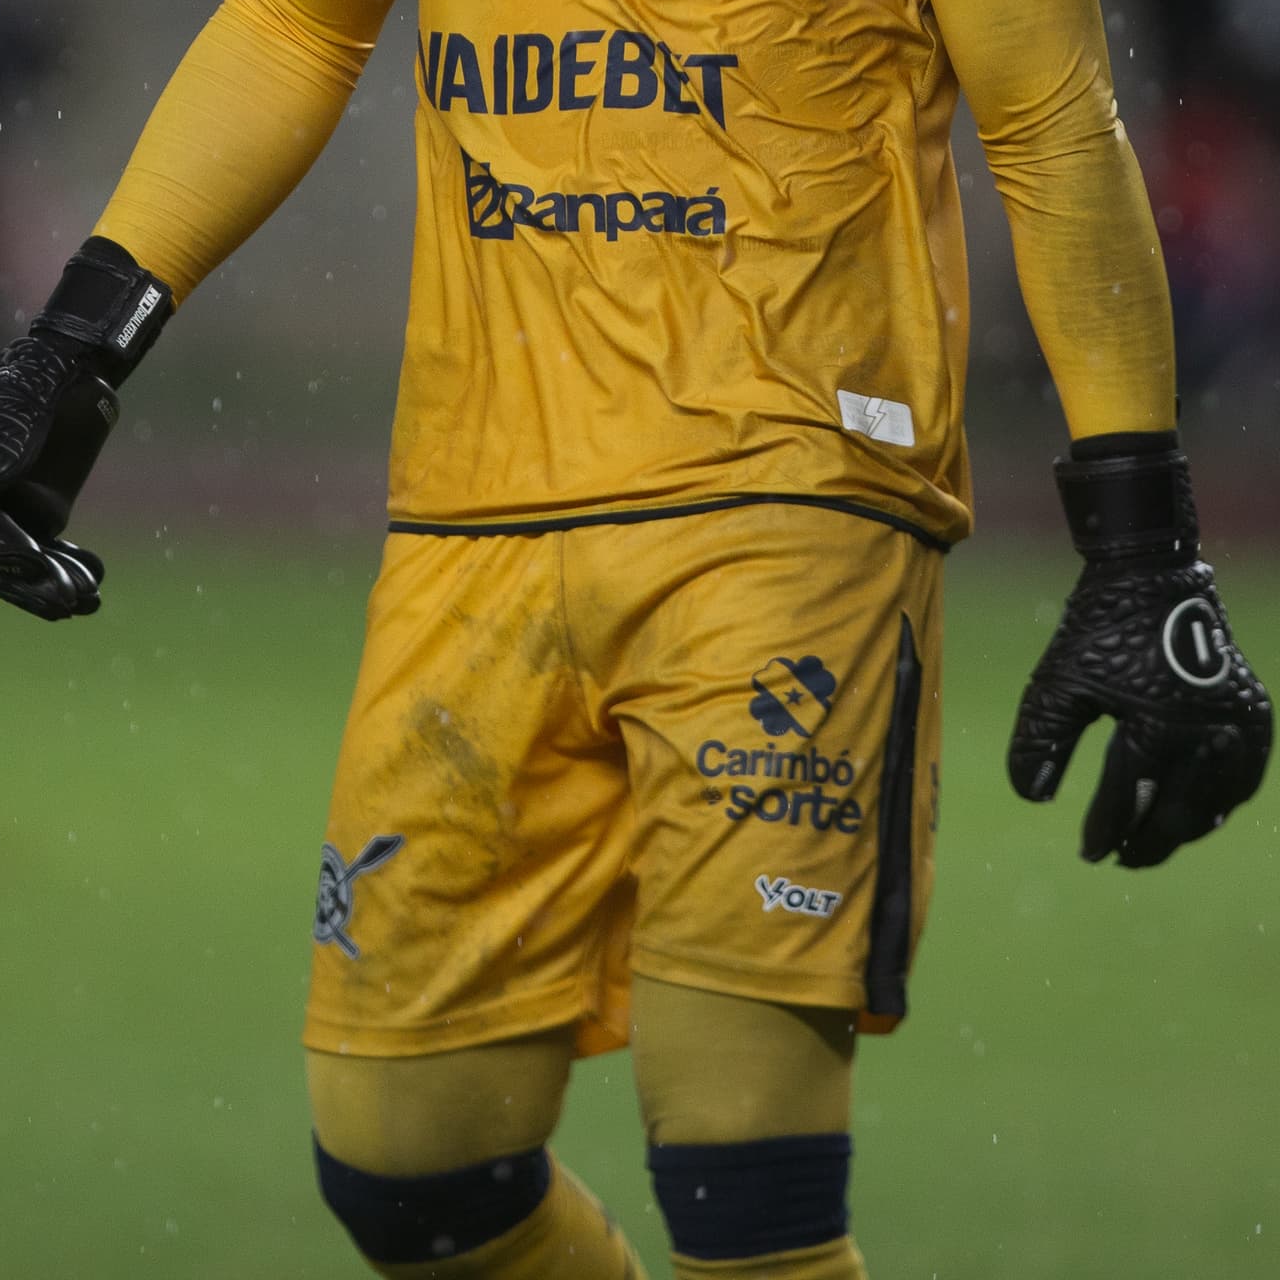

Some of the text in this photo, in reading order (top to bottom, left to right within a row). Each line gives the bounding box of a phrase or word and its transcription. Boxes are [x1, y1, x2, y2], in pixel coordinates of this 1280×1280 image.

[418, 29, 738, 130] VAIDEBET
[498, 183, 726, 241] Banpará
[116, 307, 147, 348] GOALKEEPER
[696, 740, 854, 786] Carimbó
[725, 785, 863, 833] sorte
[754, 874, 842, 918] VOLT
